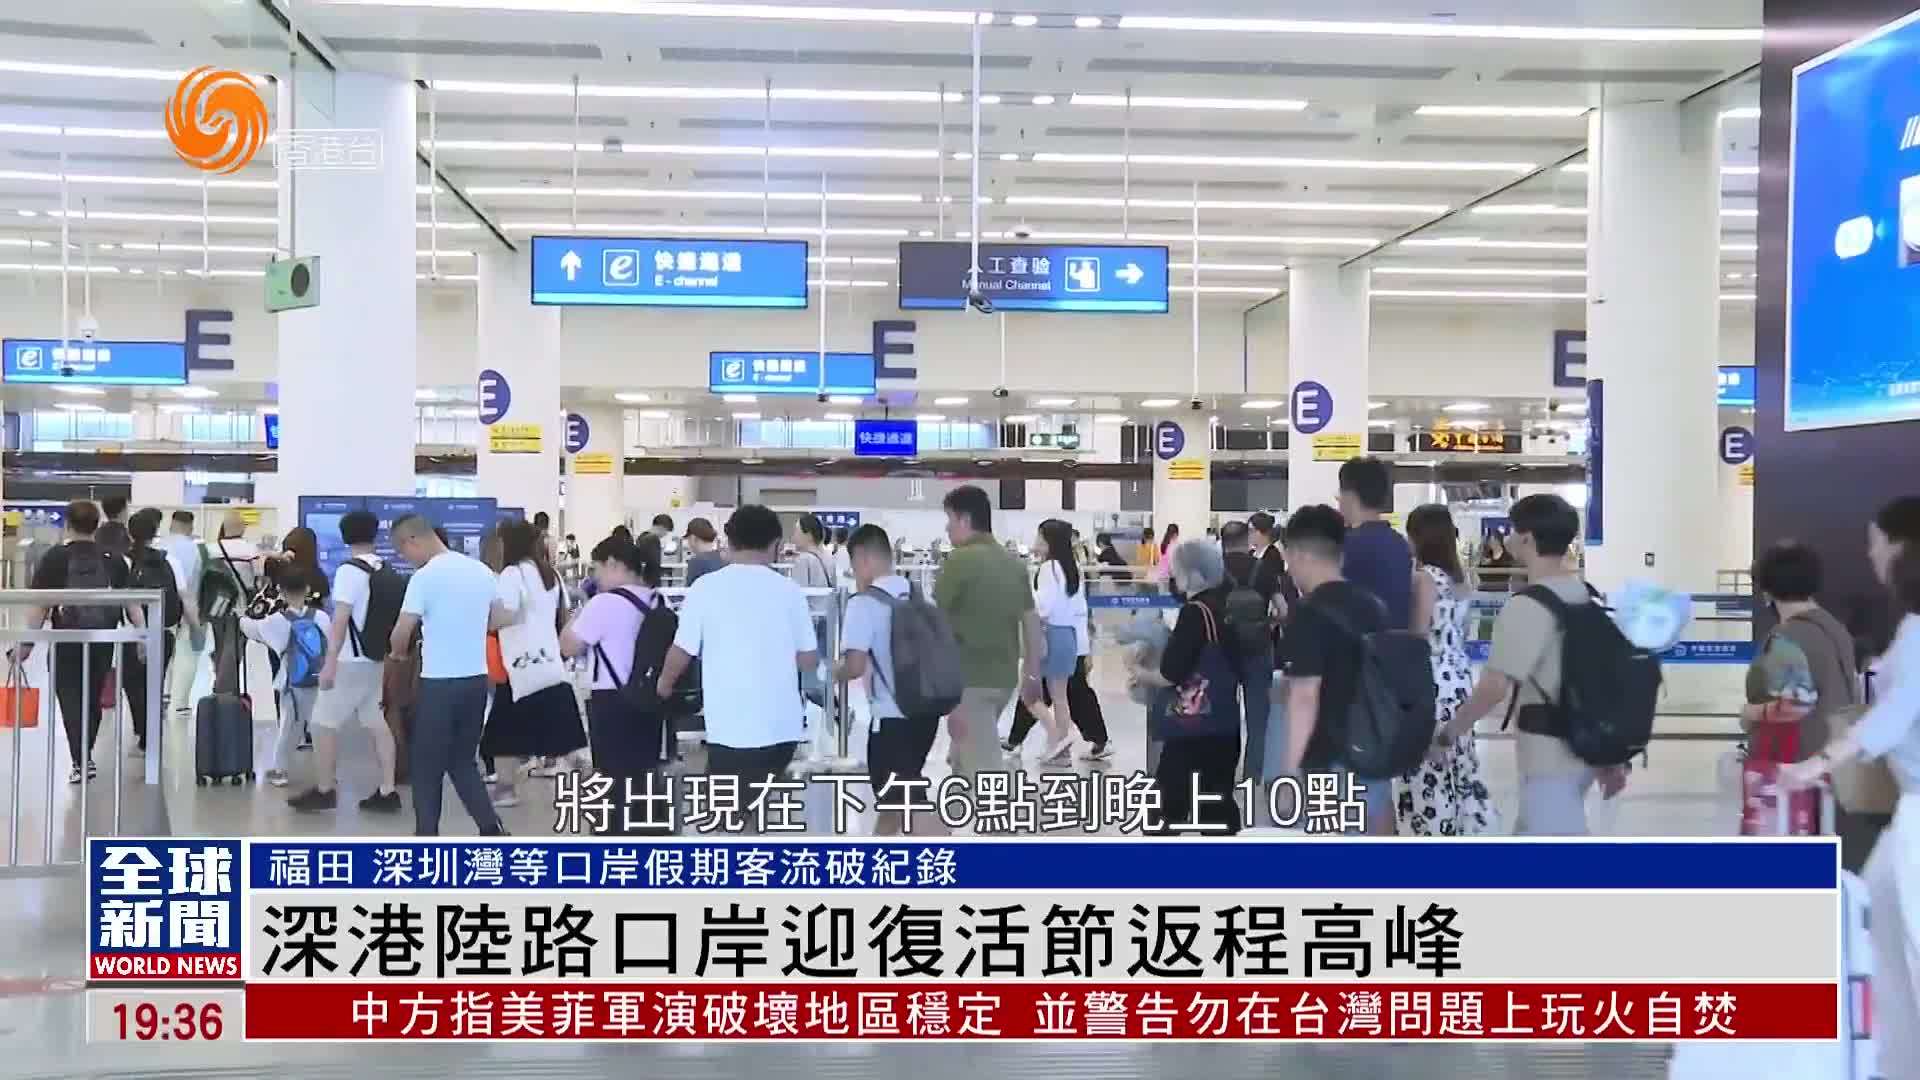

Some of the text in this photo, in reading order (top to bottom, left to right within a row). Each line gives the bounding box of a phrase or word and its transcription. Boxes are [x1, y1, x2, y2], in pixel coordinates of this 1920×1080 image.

[962, 280, 1051, 290] Mnual Channel
[185, 309, 234, 370] E
[874, 321, 916, 378] E
[1296, 388, 1319, 425] E
[1159, 427, 1175, 453] E
[1724, 432, 1745, 458] E
